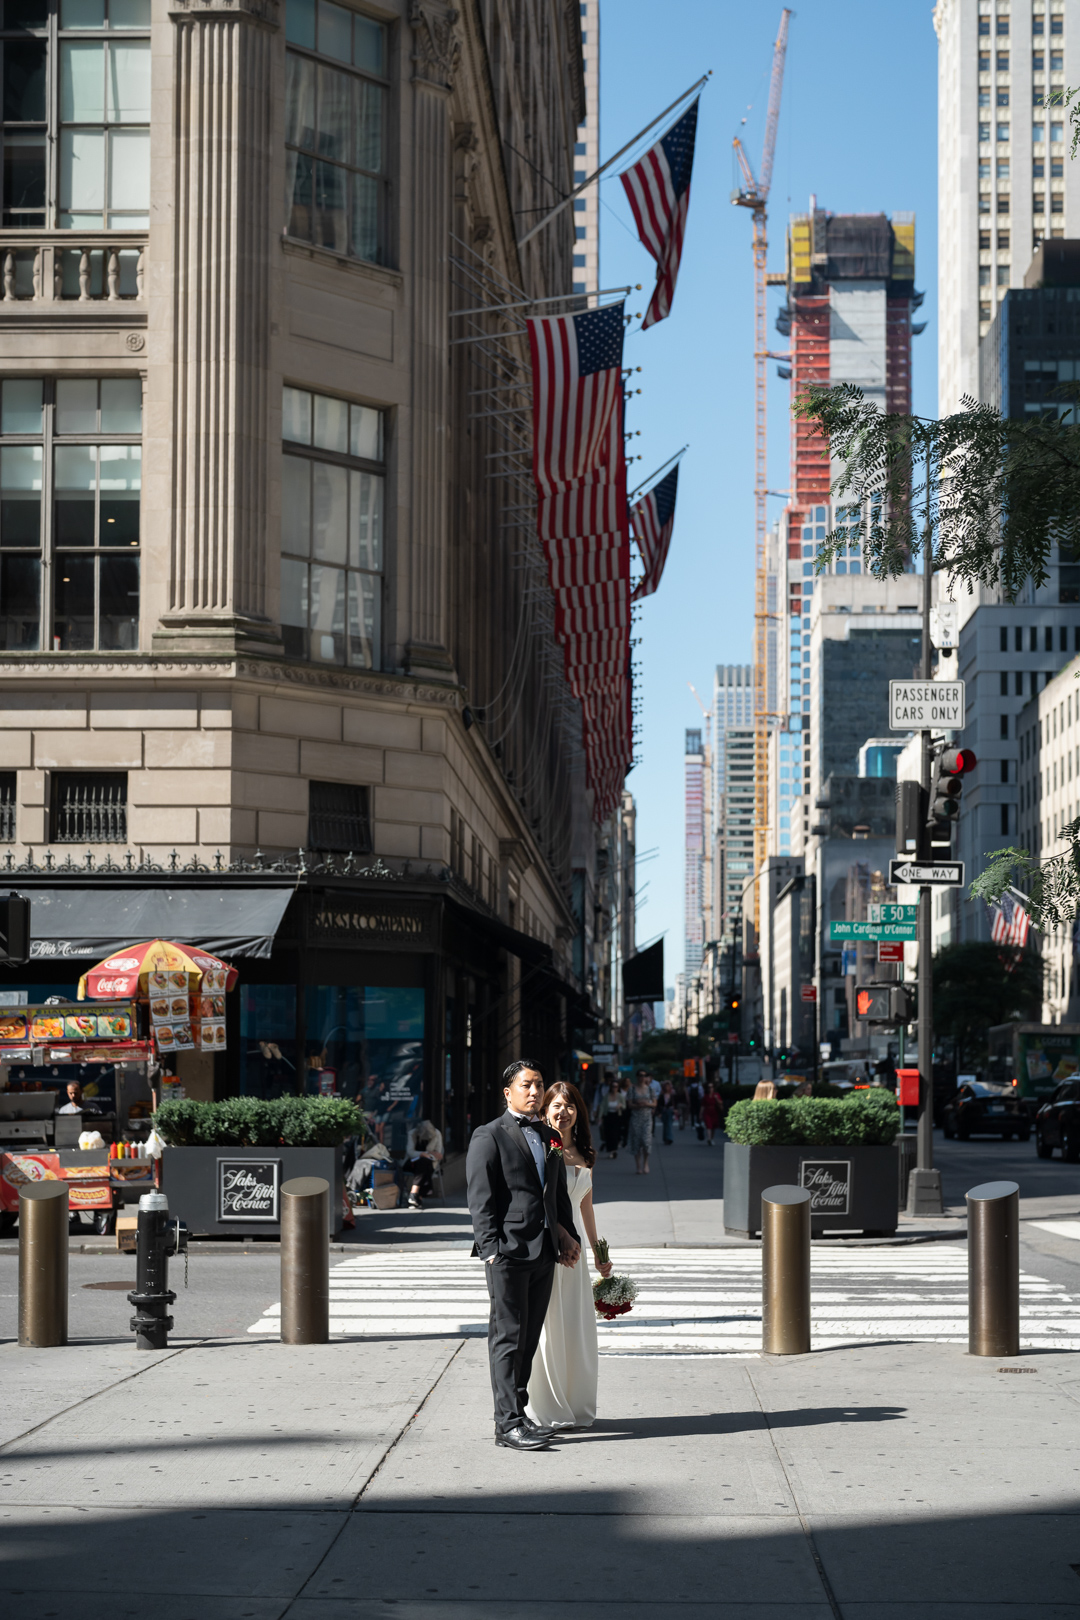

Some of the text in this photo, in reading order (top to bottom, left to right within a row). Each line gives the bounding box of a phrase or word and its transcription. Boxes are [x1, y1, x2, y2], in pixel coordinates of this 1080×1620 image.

[896, 688, 959, 701] PASSENGER
[895, 706, 959, 720] CARS ONLY
[901, 868, 954, 878] ONE WAY
[881, 906, 887, 920] E
[891, 906, 904, 921] 50
[316, 911, 347, 930] SAKS
[357, 914, 423, 933] COMPANY
[834, 923, 913, 935] John Cardinal O'Connor
[31, 940, 93, 957] Fifth Avenue
[1041, 1037, 1071, 1046] COFFEE
[223, 1169, 257, 1190] Saks
[804, 1168, 834, 1188] Saks
[223, 1192, 271, 1211] Avenue
